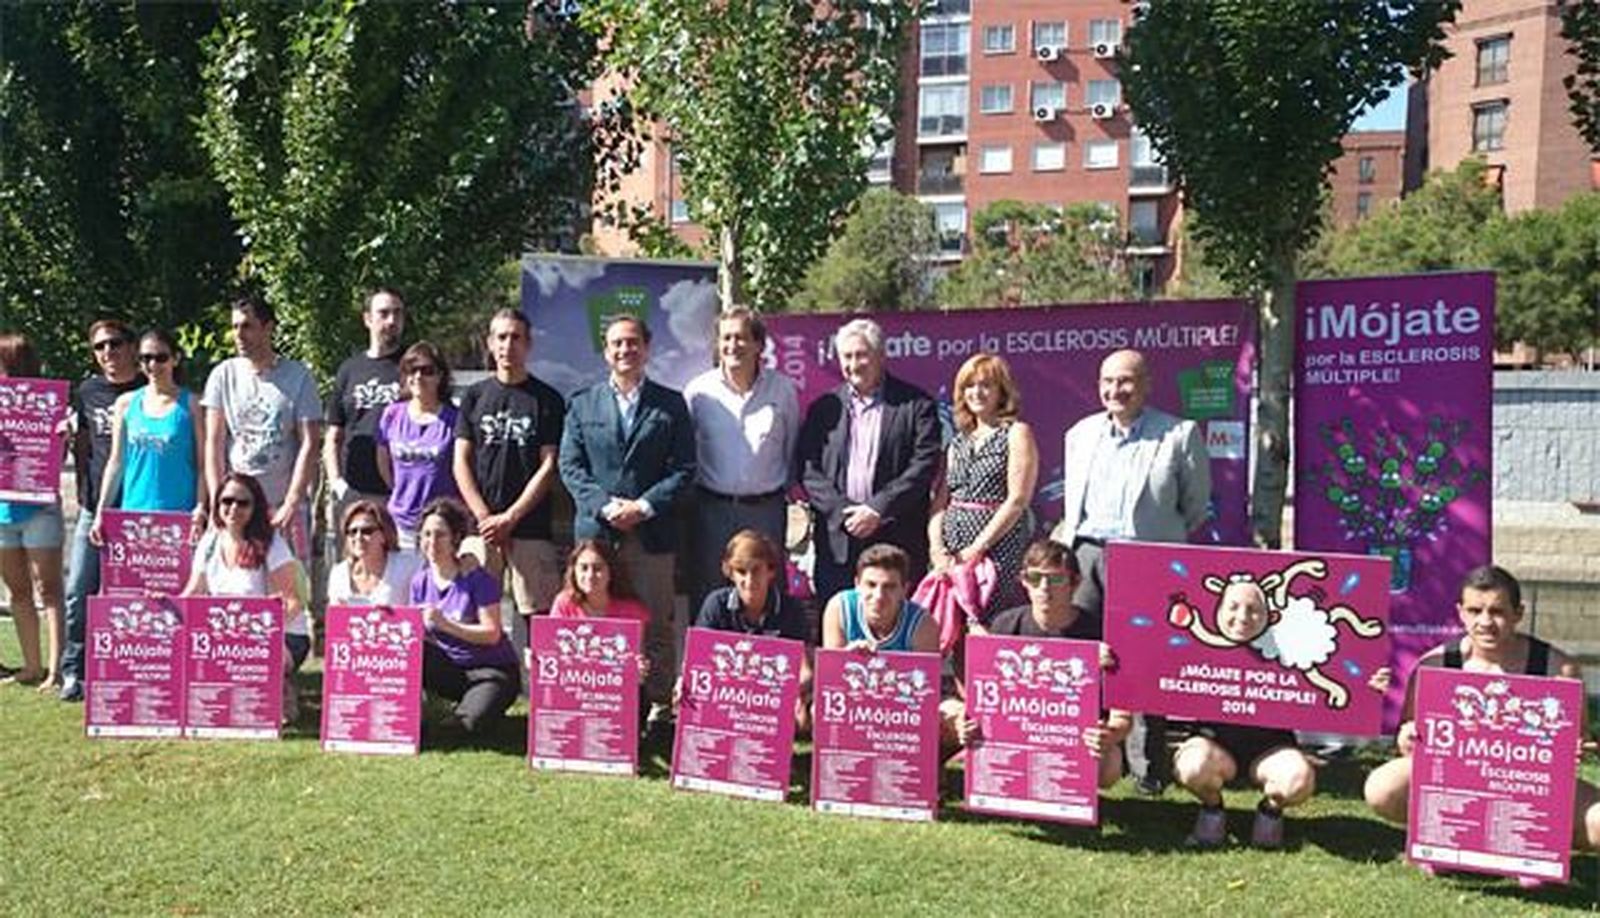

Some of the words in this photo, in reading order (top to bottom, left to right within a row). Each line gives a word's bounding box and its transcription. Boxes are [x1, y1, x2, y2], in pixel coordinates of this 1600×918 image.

[1305, 299, 1481, 346] ¡Mójate
[937, 339, 974, 360] por
[979, 333, 1000, 353] la
[1006, 328, 1128, 352] ESCLEROSIS
[1134, 322, 1238, 347] MÚLTIPLE!
[1305, 353, 1337, 369] por
[1339, 351, 1356, 365] la
[1359, 346, 1481, 365] ESCLEROSIS
[1304, 368, 1401, 384] MÚLTIPLE!
[108, 542, 126, 562] 13
[127, 553, 180, 568] ¡Mójate
[93, 632, 112, 654] 13
[113, 644, 172, 662] ¡Mójate
[191, 631, 211, 654] 13
[211, 644, 270, 662] ¡Mójate
[331, 643, 351, 666] 13
[351, 655, 408, 673] ¡Mójate
[538, 655, 559, 680] 13
[559, 669, 624, 689] ¡Mójate
[1179, 664, 1241, 681] ¡MÓJATE
[1245, 670, 1276, 685] POR
[1279, 673, 1298, 687] LA
[689, 669, 713, 694] 13
[1159, 677, 1241, 698] ESCLEROSIS
[1244, 685, 1317, 705] MÚLTIPLE!
[712, 686, 782, 709] ¡Mójate
[822, 691, 847, 717] 13
[973, 680, 1000, 707] 13
[848, 706, 921, 728] ¡Mójate
[1001, 697, 1081, 718] ¡Mójate
[1222, 700, 1257, 715] 2014
[1424, 718, 1455, 748] 13
[1458, 737, 1553, 764] ¡Mójate
